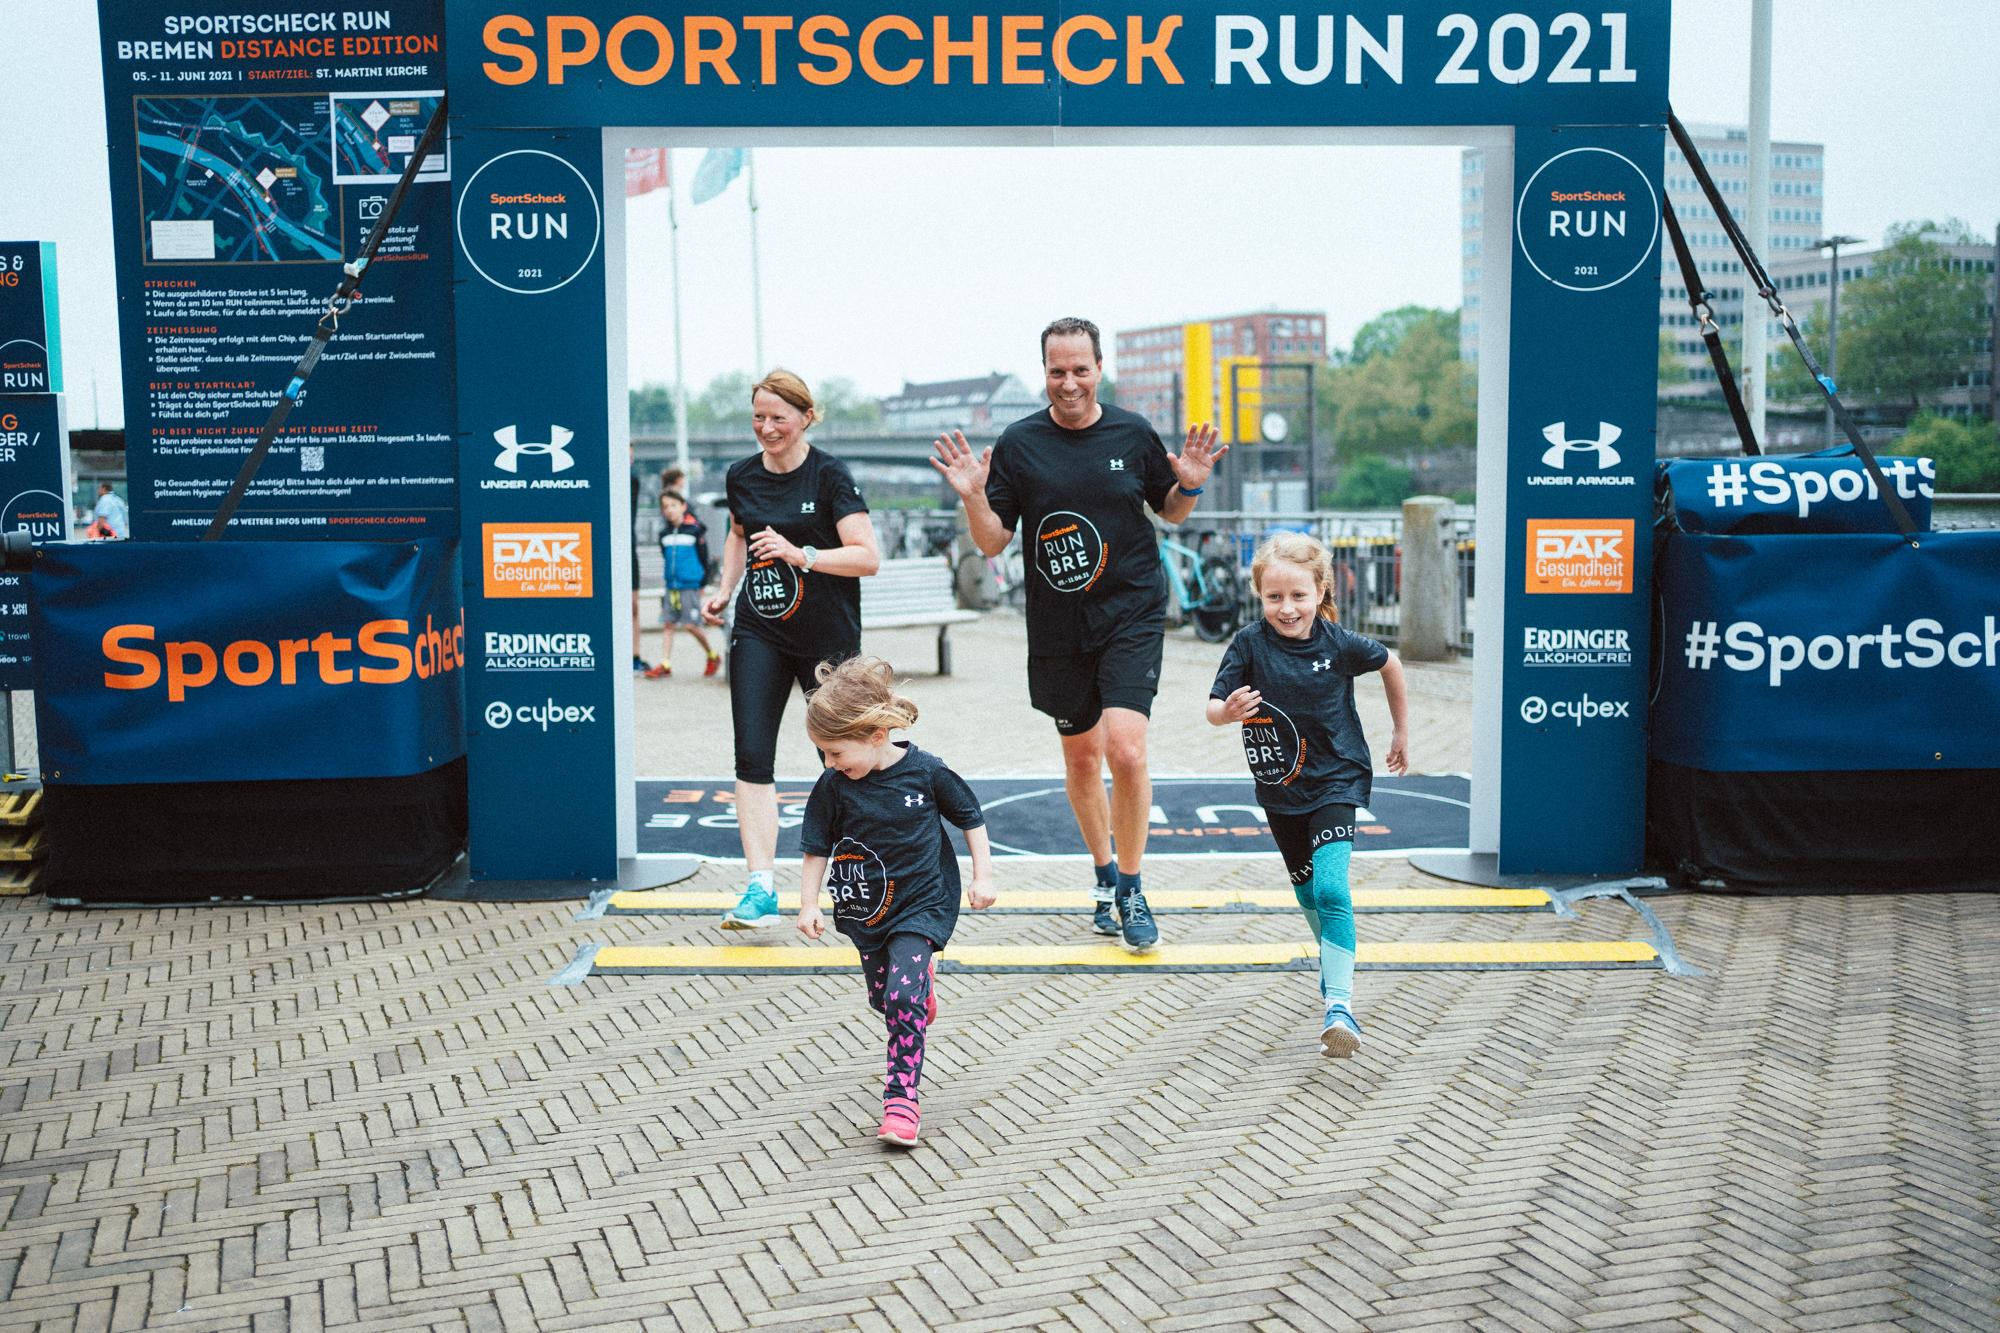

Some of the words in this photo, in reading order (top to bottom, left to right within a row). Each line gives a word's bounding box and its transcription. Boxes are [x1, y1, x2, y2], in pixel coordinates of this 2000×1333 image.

[164, 12, 336, 34] SPORTSCHECK
[343, 11, 390, 30] RUN
[118, 40, 213, 59] BREMEN
[221, 38, 336, 58] DISTANCE
[343, 35, 438, 55] EDITION
[482, 14, 1185, 86] SPORTSCHECK
[1215, 14, 1404, 85] RUN
[1435, 12, 1637, 84] 2021
[178, 71, 205, 80] JUNI
[208, 71, 232, 80] 2021
[248, 70, 313, 80] START/ZIEL:
[316, 68, 332, 78] ST.
[335, 67, 382, 78] MARTINI
[386, 66, 428, 76] KIRCHE
[490, 193, 566, 204] SportScheck
[1551, 191, 1626, 202] SportScheck
[491, 213, 568, 239] RUN
[1550, 210, 1626, 237] RUN
[13, 255, 24, 271] &
[1574, 266, 1598, 275] 2021
[518, 269, 542, 278] 2021
[167, 289, 226, 299] ausgeschilderte
[189, 308, 221, 316] Strecke,
[278, 306, 320, 316] angemeldet
[169, 336, 217, 345] Zeitmessung
[278, 335, 297, 344] Chip,
[365, 332, 424, 342] Startunterlagen
[4, 372, 43, 387] RUN
[188, 392, 206, 400] Chip
[158, 401, 182, 410] Trägst
[212, 400, 260, 409] SportScheck
[212, 411, 229, 419] gut?
[181, 437, 212, 446] probiere
[174, 446, 239, 455] Live-Ergebnisliste
[480, 480, 527, 489] UNDER
[1527, 476, 1573, 485] UNDER
[154, 489, 191, 498] geltenden
[328, 516, 426, 524] SPORTSCHECK.COM/RUN
[493, 533, 581, 563] DAK
[1044, 532, 1084, 557] RUN
[1536, 529, 1623, 559] DAK
[1050, 550, 1089, 575] BRE
[1536, 559, 1624, 577] Gesundheit
[493, 563, 582, 581] Gesundheit
[753, 583, 786, 600] BRE
[485, 632, 594, 656] ERDINGER
[1524, 627, 1630, 651] ERDINGER
[485, 657, 595, 668] ALKOHOLFREI
[1523, 653, 1631, 663] ALKOHOLFREI
[516, 698, 595, 732] cybex
[1551, 693, 1629, 727] cybex
[1242, 727, 1279, 745] RUN
[1246, 746, 1285, 764] BRE
[1312, 826, 1354, 847] MODE
[827, 882, 870, 903] BRE
